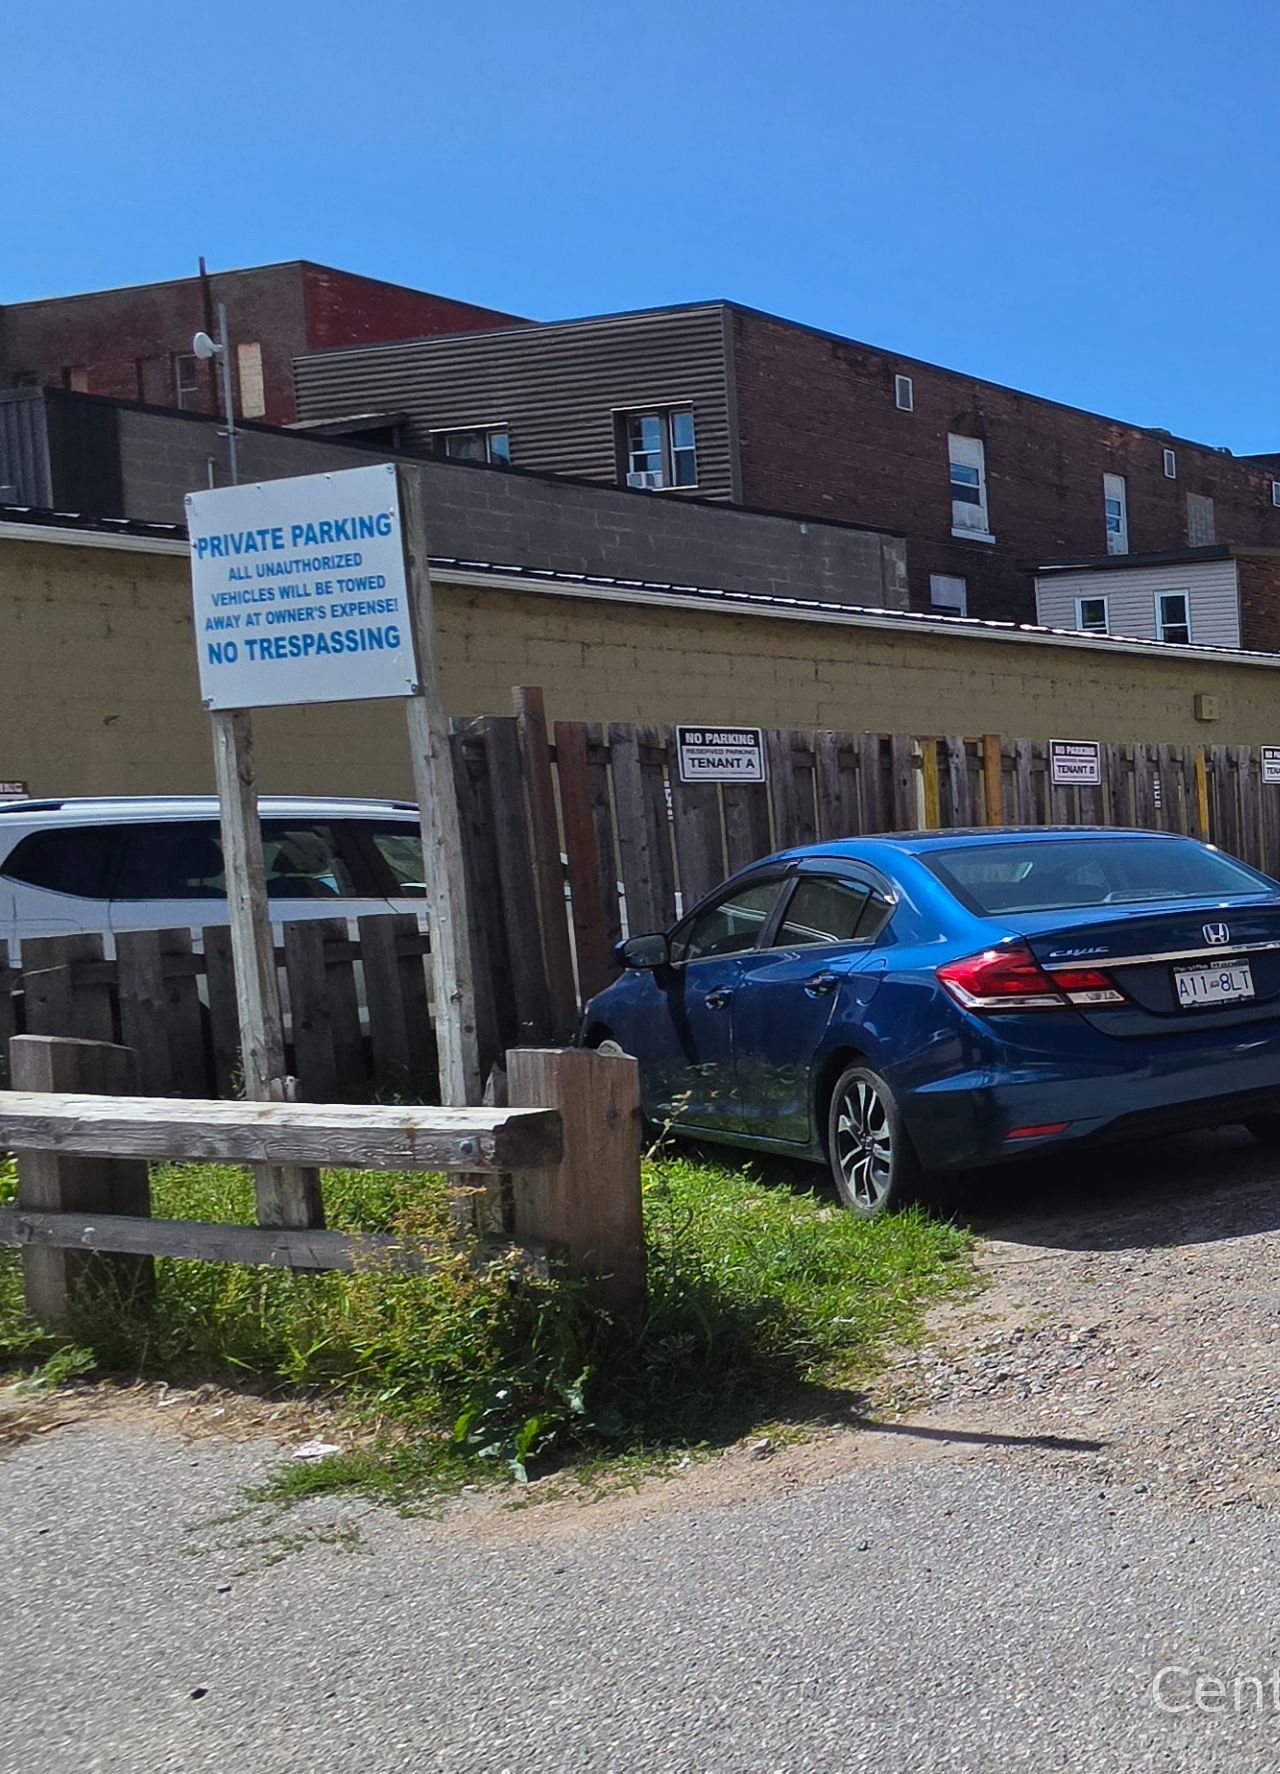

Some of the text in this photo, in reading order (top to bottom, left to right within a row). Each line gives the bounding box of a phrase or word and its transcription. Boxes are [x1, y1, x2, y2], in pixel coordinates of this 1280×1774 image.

[196, 512, 393, 559] PRIVATE PARKING
[228, 552, 363, 582] ALL UNAUTHORIZED
[211, 574, 386, 607] VEHICLES WILL BE TOWED
[205, 597, 399, 632] AWAY AT OWNER'S EXPENSE!
[207, 625, 401, 665] NO TRESPASSING
[685, 732, 755, 745] NO PARKING
[688, 757, 755, 768] TENANT A
[1057, 765, 1095, 774] TENANT B
